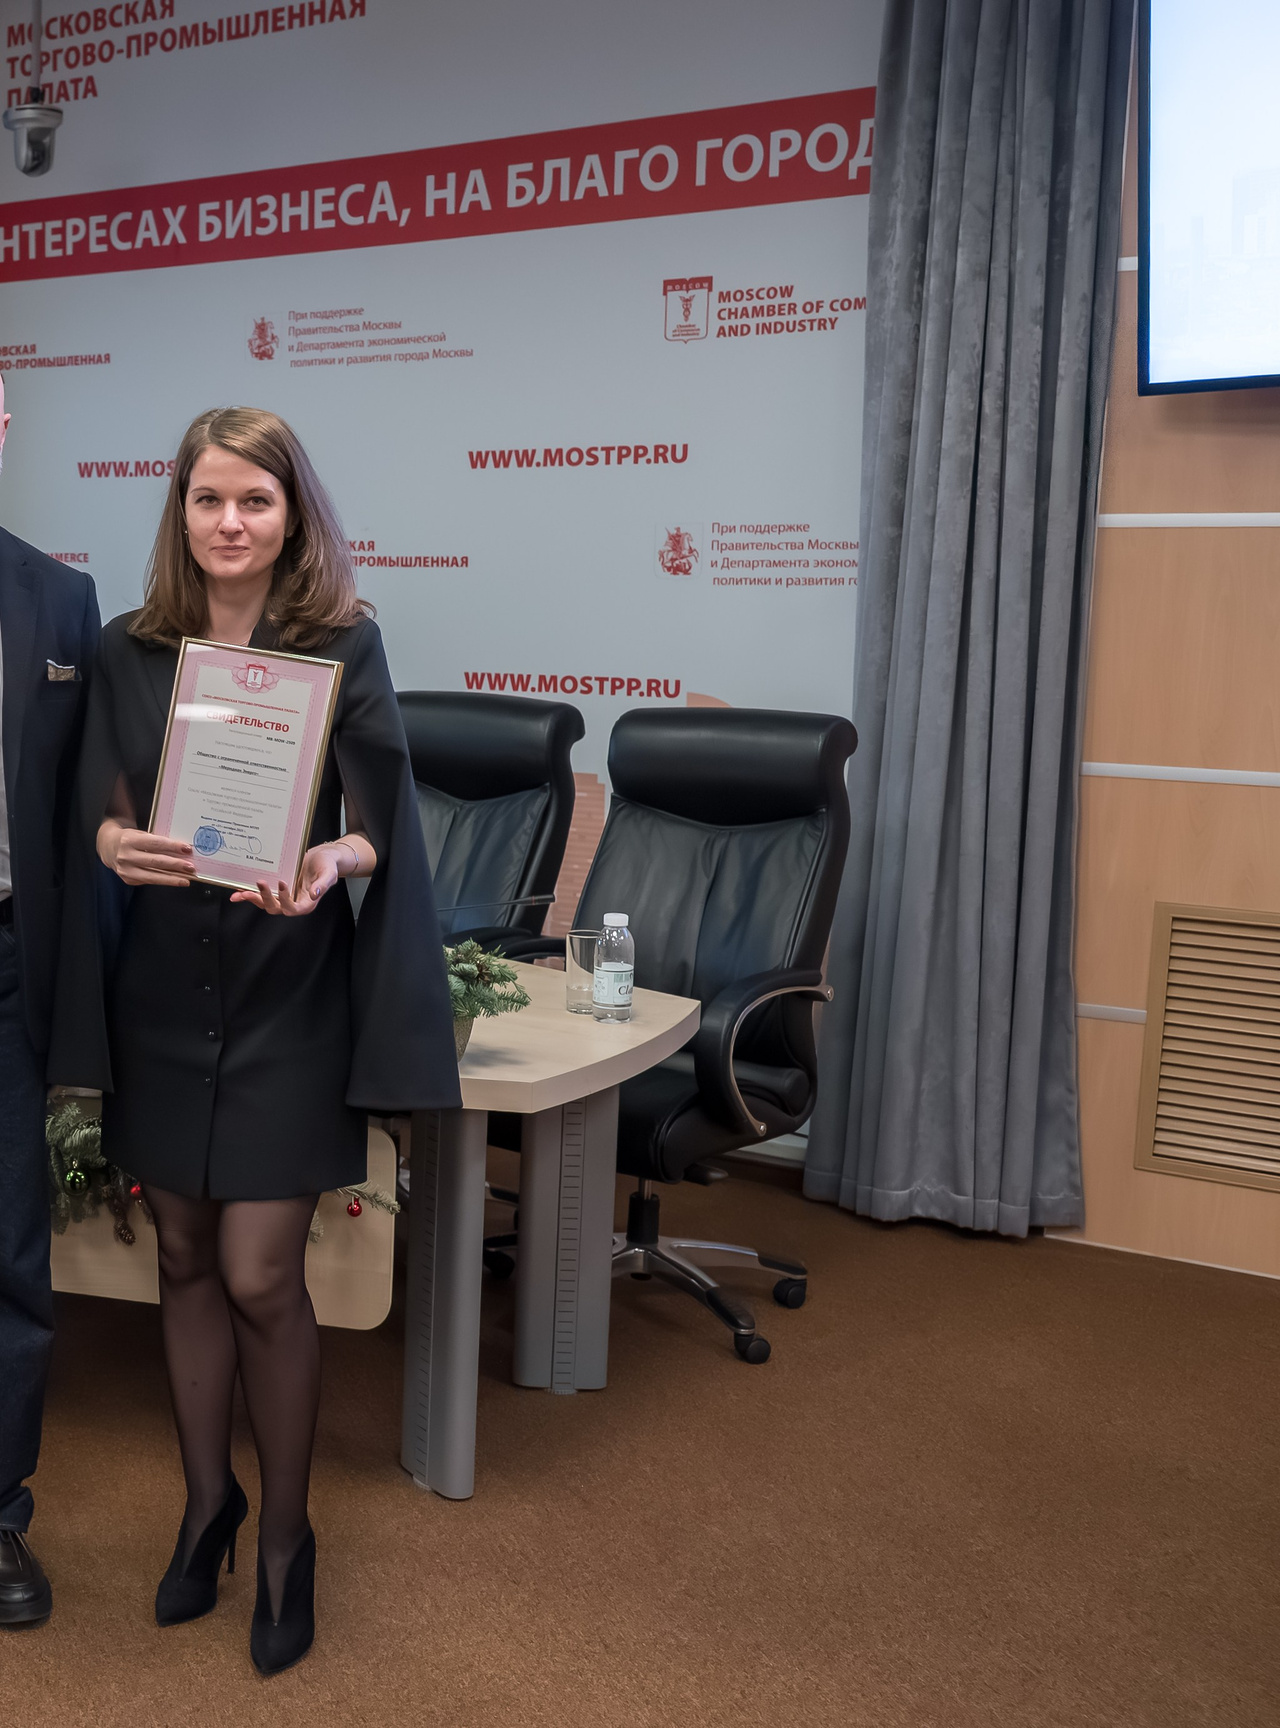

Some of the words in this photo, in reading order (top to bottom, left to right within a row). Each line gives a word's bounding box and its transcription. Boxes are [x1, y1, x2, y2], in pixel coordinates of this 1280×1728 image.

[198, 181, 410, 243] БИЗНЕСА,
[425, 169, 492, 217] НА
[507, 144, 679, 208] БЛАГО
[718, 285, 794, 303] MOSCOW
[288, 310, 308, 322] При
[309, 307, 365, 320] поддержке
[717, 302, 798, 321] CHAMBER
[802, 300, 825, 314] OF
[288, 325, 360, 338] Правительства
[362, 320, 402, 331] Москвы
[716, 323, 751, 338] AND
[755, 317, 839, 335] INDUSTRY
[288, 344, 294, 352] и
[296, 340, 365, 353] Департамента
[367, 332, 446, 348] экономической
[290, 356, 335, 368] политики
[338, 356, 344, 364] и
[346, 353, 392, 366] развития
[394, 351, 430, 363] города
[432, 348, 474, 359] Москвы
[468, 443, 689, 469] WWW.MOSTPP.RU
[711, 522, 736, 535] При
[740, 523, 810, 535] поддержке
[711, 540, 804, 553] Правительства
[808, 539, 859, 550] Москвы
[710, 559, 718, 568] и
[721, 557, 810, 570] Департамента
[713, 577, 771, 586] политики
[775, 577, 782, 585] и
[786, 577, 845, 588] развития
[463, 671, 681, 699] WWW.MOSTPP.RU
[207, 711, 290, 732] СВИДЕТЕЛЬСТВО
